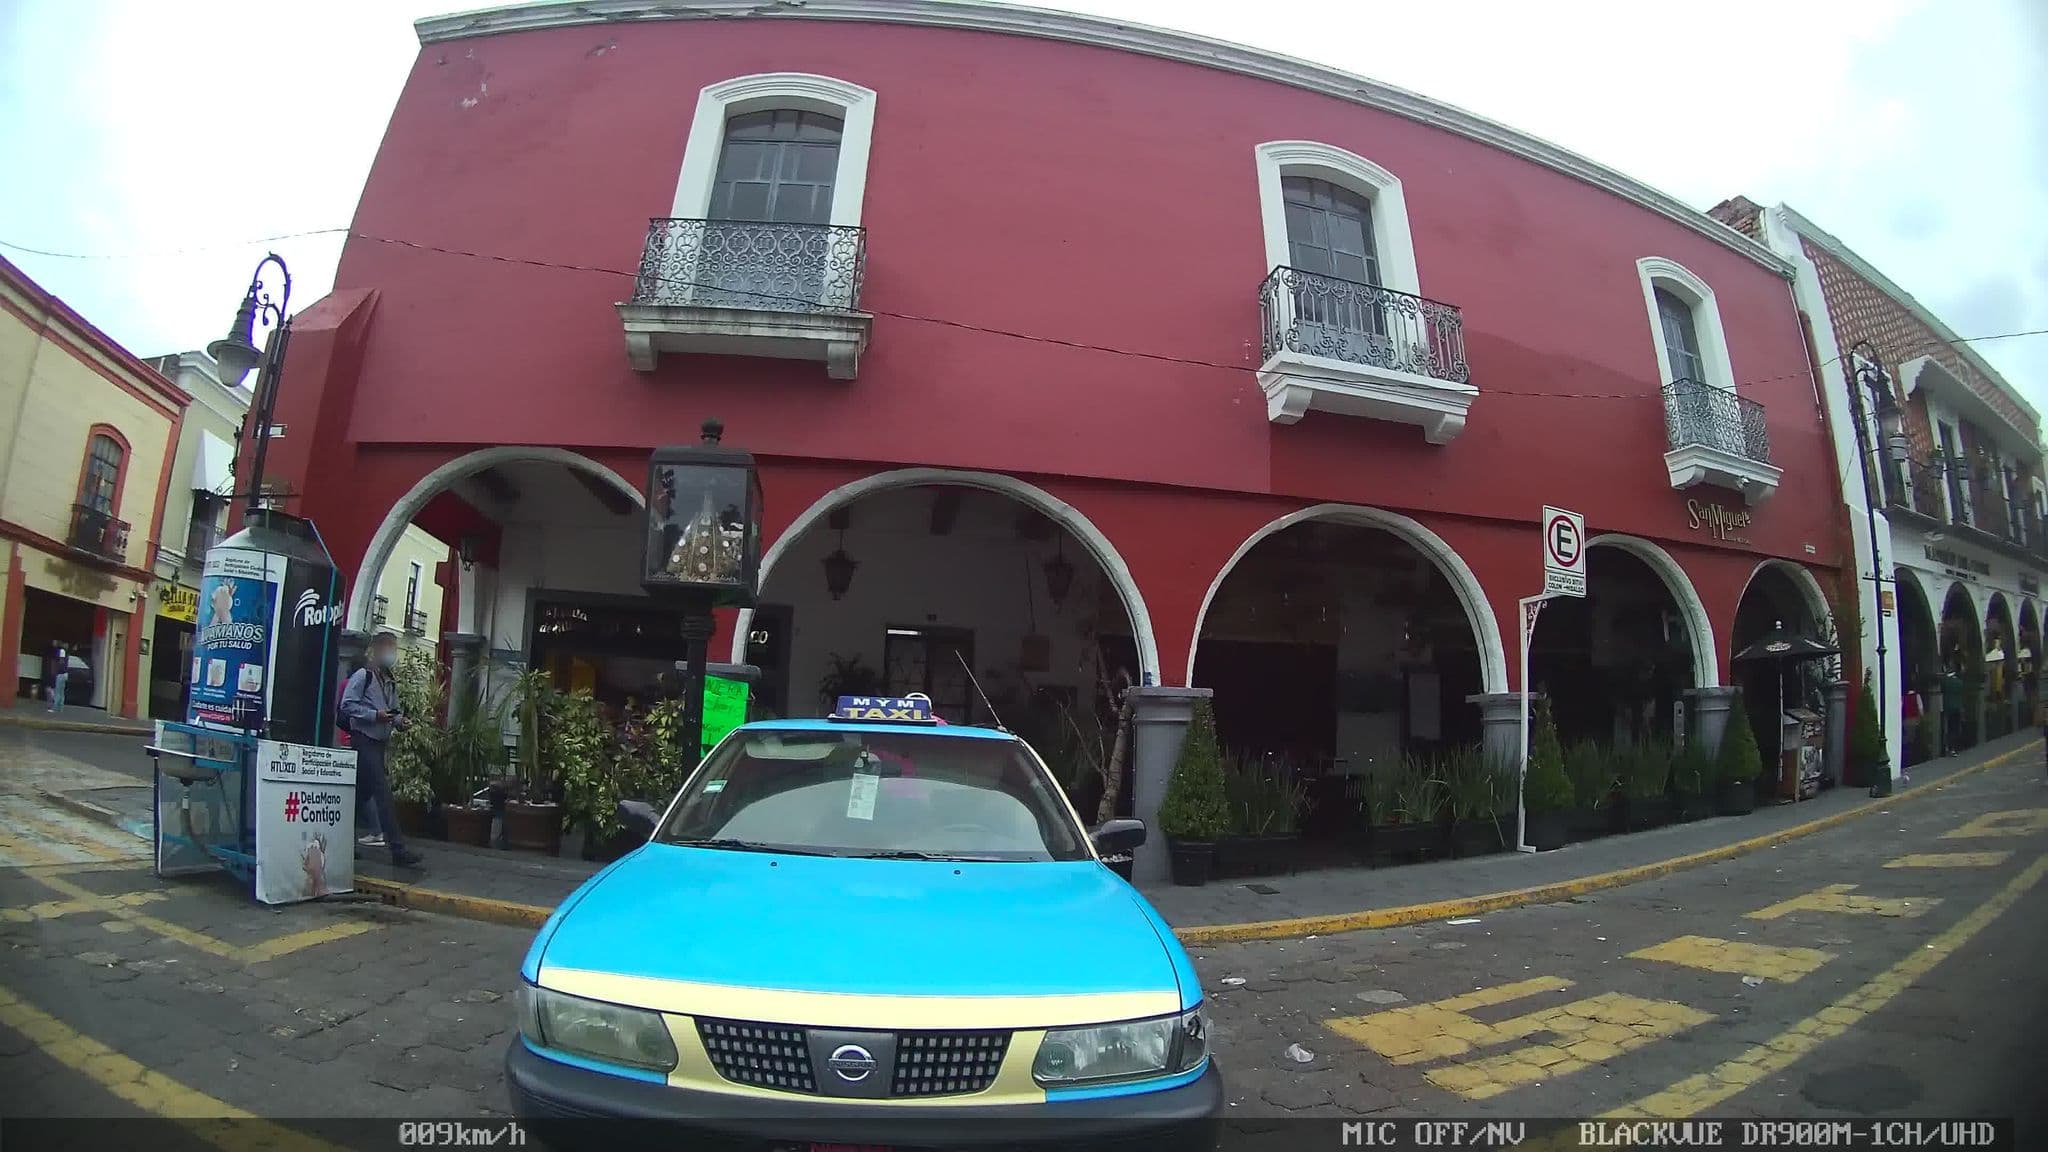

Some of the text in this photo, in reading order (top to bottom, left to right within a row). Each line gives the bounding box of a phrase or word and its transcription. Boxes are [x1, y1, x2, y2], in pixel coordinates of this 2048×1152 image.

[1687, 498, 1746, 540] San Miguel
[1557, 523, 1573, 558] E
[219, 640, 227, 649] TU
[228, 640, 253, 650] SALUD
[843, 708, 922, 720] TAXI
[301, 805, 341, 826] Contigo
